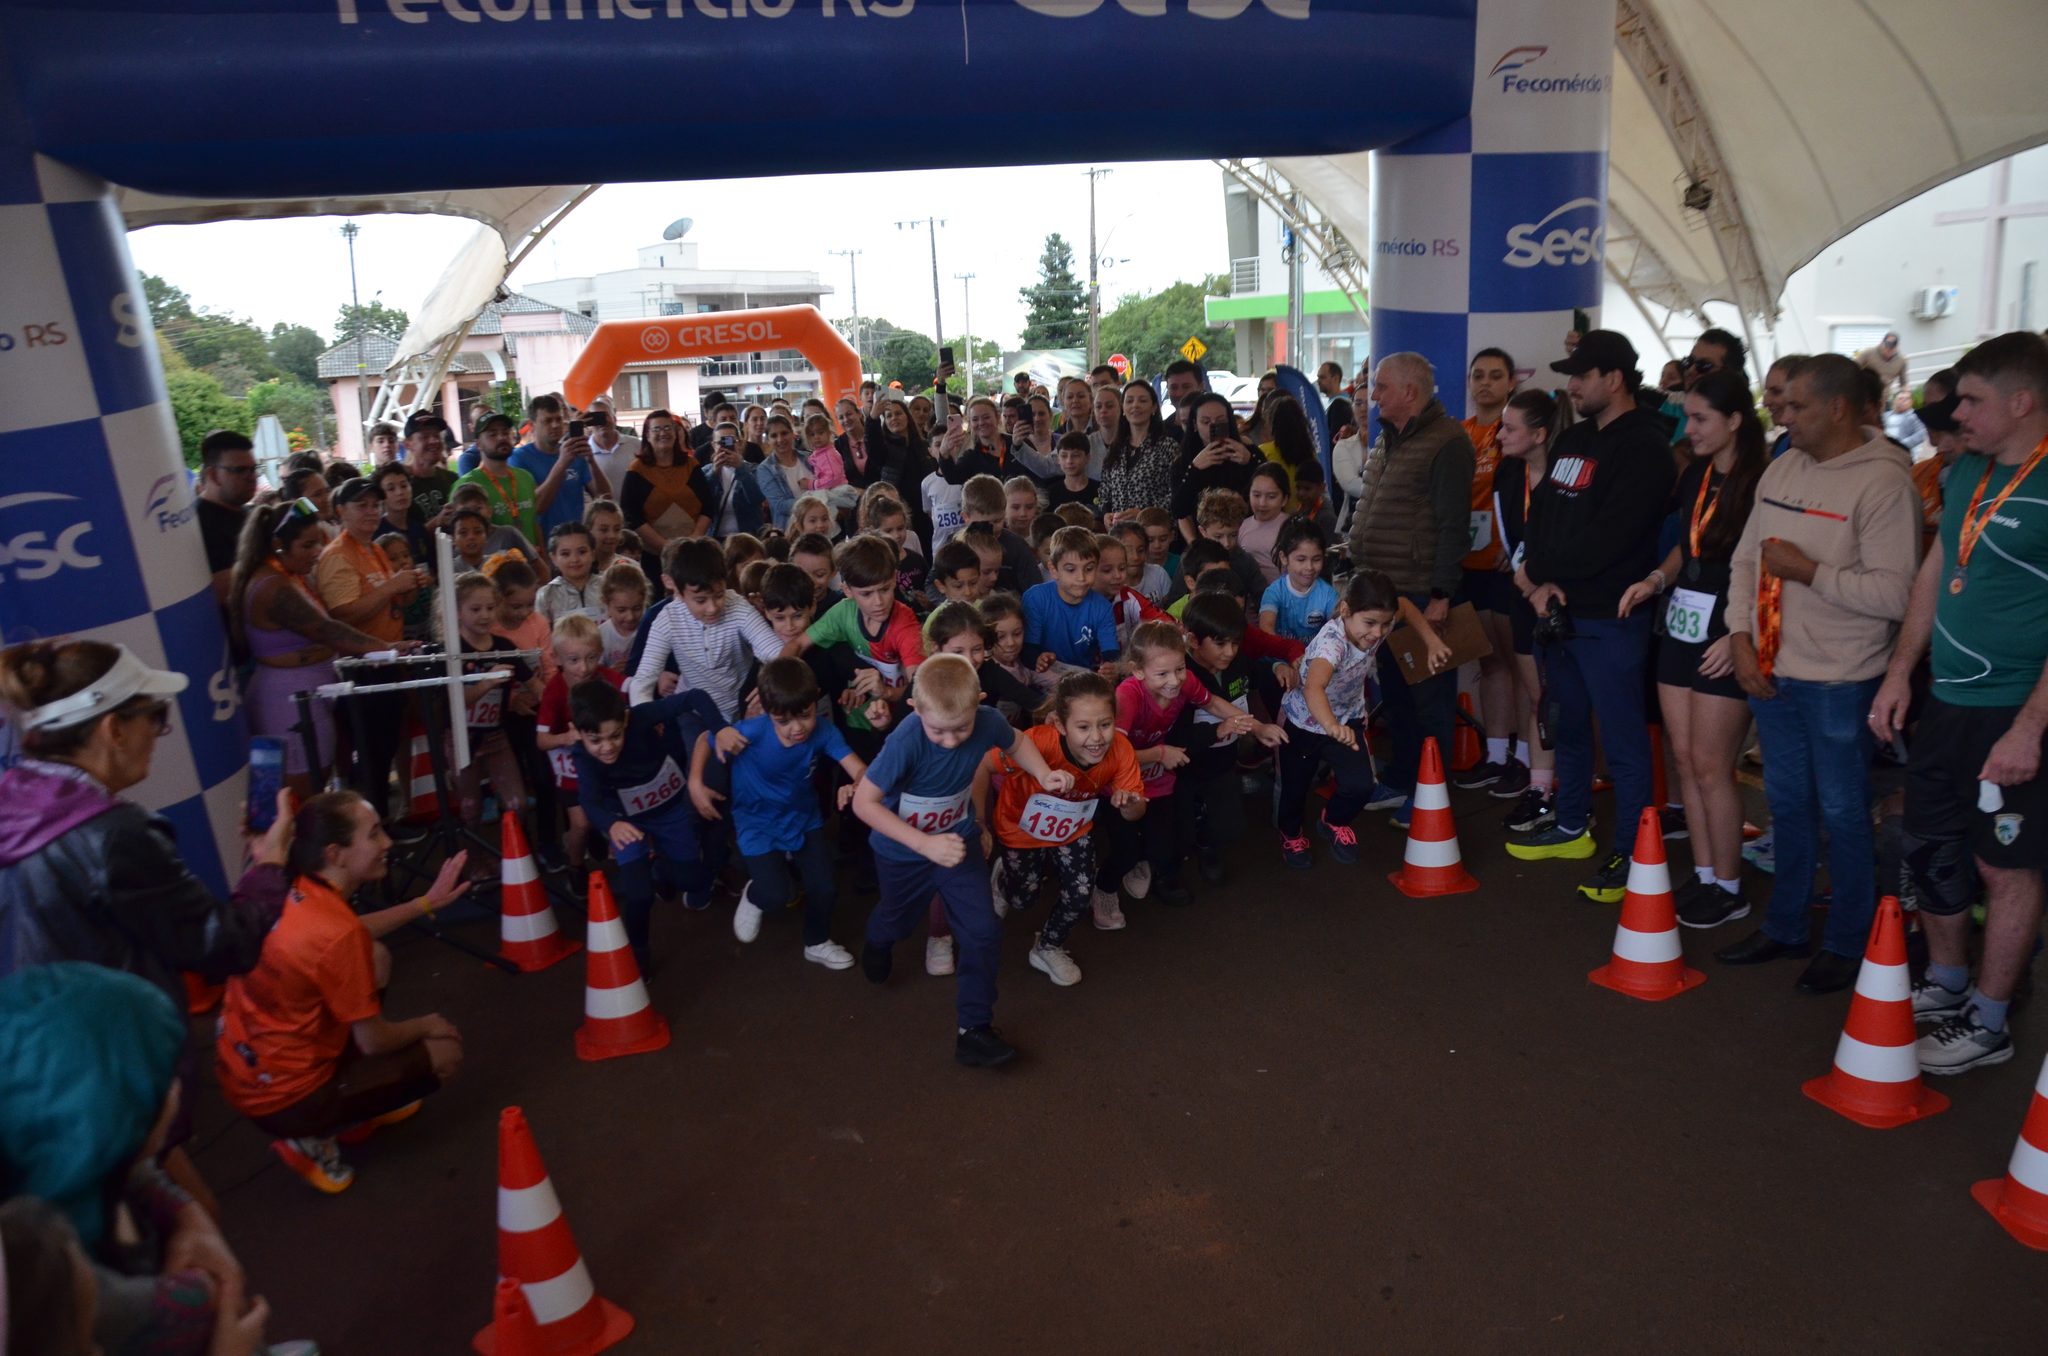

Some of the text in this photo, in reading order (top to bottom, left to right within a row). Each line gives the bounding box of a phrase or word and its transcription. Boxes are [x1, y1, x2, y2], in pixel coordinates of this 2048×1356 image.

[1433, 239, 1460, 257] RS
[23, 321, 68, 348] RS
[678, 320, 782, 347] CRESOL
[1669, 604, 1700, 638] 293
[631, 772, 682, 811] 1266
